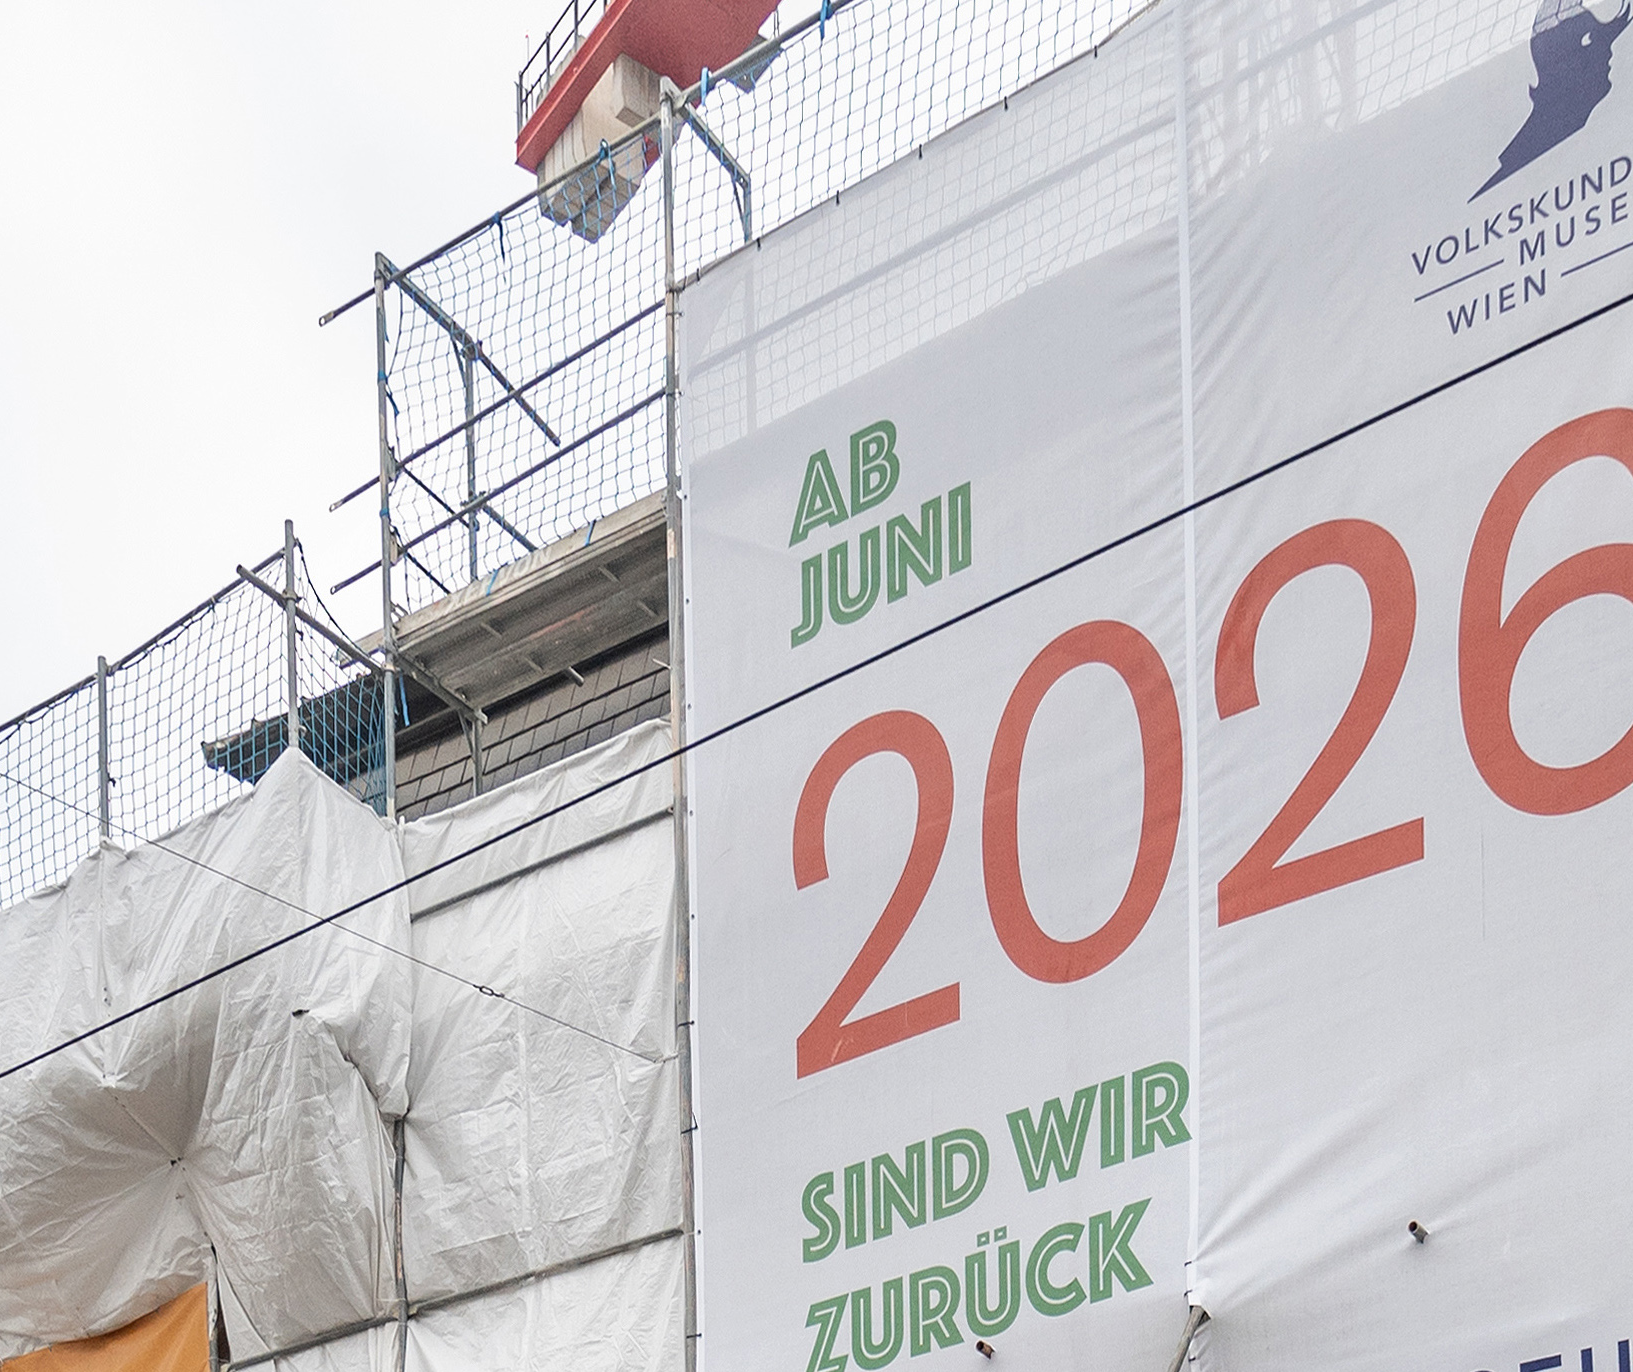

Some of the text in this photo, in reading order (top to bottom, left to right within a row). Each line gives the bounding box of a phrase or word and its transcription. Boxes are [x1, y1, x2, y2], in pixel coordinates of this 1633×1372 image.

[1446, 269, 1548, 335] WIEN
[788, 419, 900, 549] AB
[790, 480, 973, 649] JUNI
[800, 1059, 1192, 1264] SIND WIR
